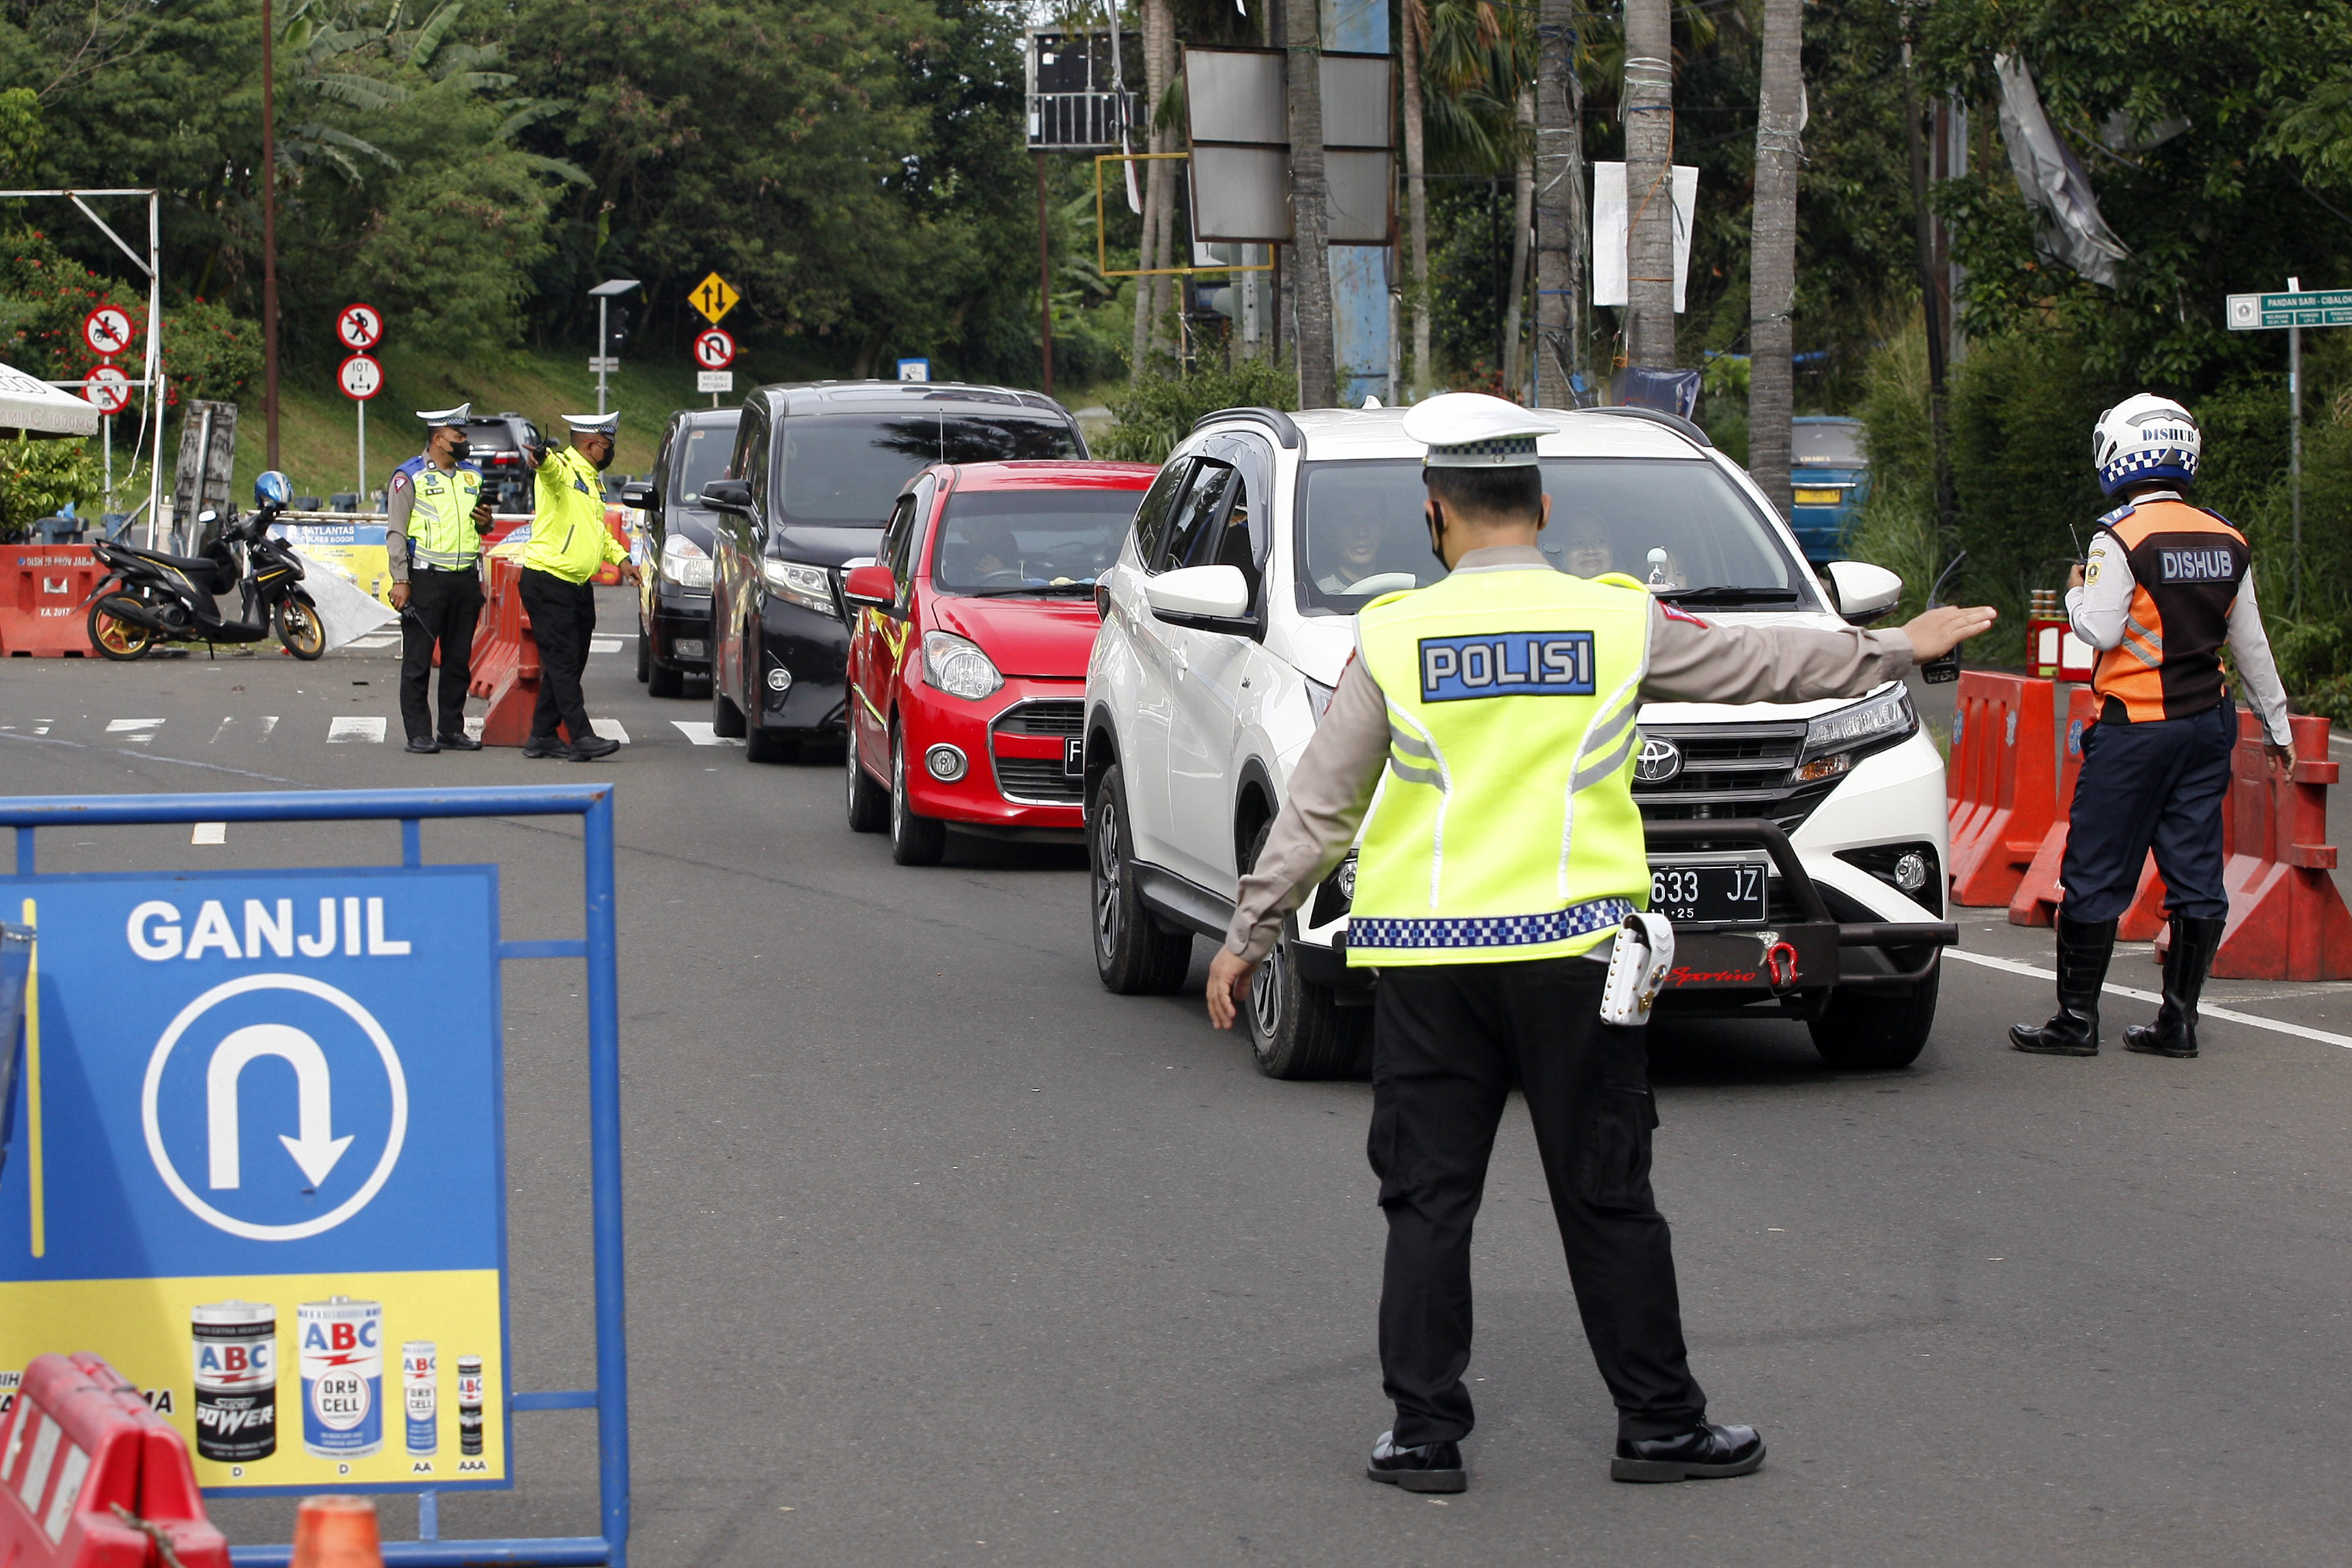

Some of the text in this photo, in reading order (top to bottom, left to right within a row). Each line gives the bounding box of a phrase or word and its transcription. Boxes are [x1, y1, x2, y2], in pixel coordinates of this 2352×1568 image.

[2267, 298, 2297, 307] PANDAN
[2298, 297, 2316, 306] SARI
[2142, 428, 2194, 442] DISHUB
[301, 526, 355, 534] SATLANTAS
[2162, 550, 2233, 579] DISHUB
[54, 608, 71, 616] 2017
[1425, 640, 1590, 691] POLISI
[1070, 741, 1081, 762] F
[1651, 870, 1758, 902] 633 JZ
[126, 897, 411, 961] GANJIL
[305, 1320, 376, 1350] ABC
[201, 1345, 268, 1370] ABC
[404, 1358, 436, 1370] ABC
[325, 1380, 357, 1394] DRY
[460, 1379, 482, 1392] ABC
[323, 1398, 359, 1412] CELL
[197, 1405, 274, 1435] POWER
[232, 1467, 242, 1476] D
[339, 1465, 349, 1473] D
[413, 1462, 432, 1471] AA
[459, 1461, 486, 1470] AAA
